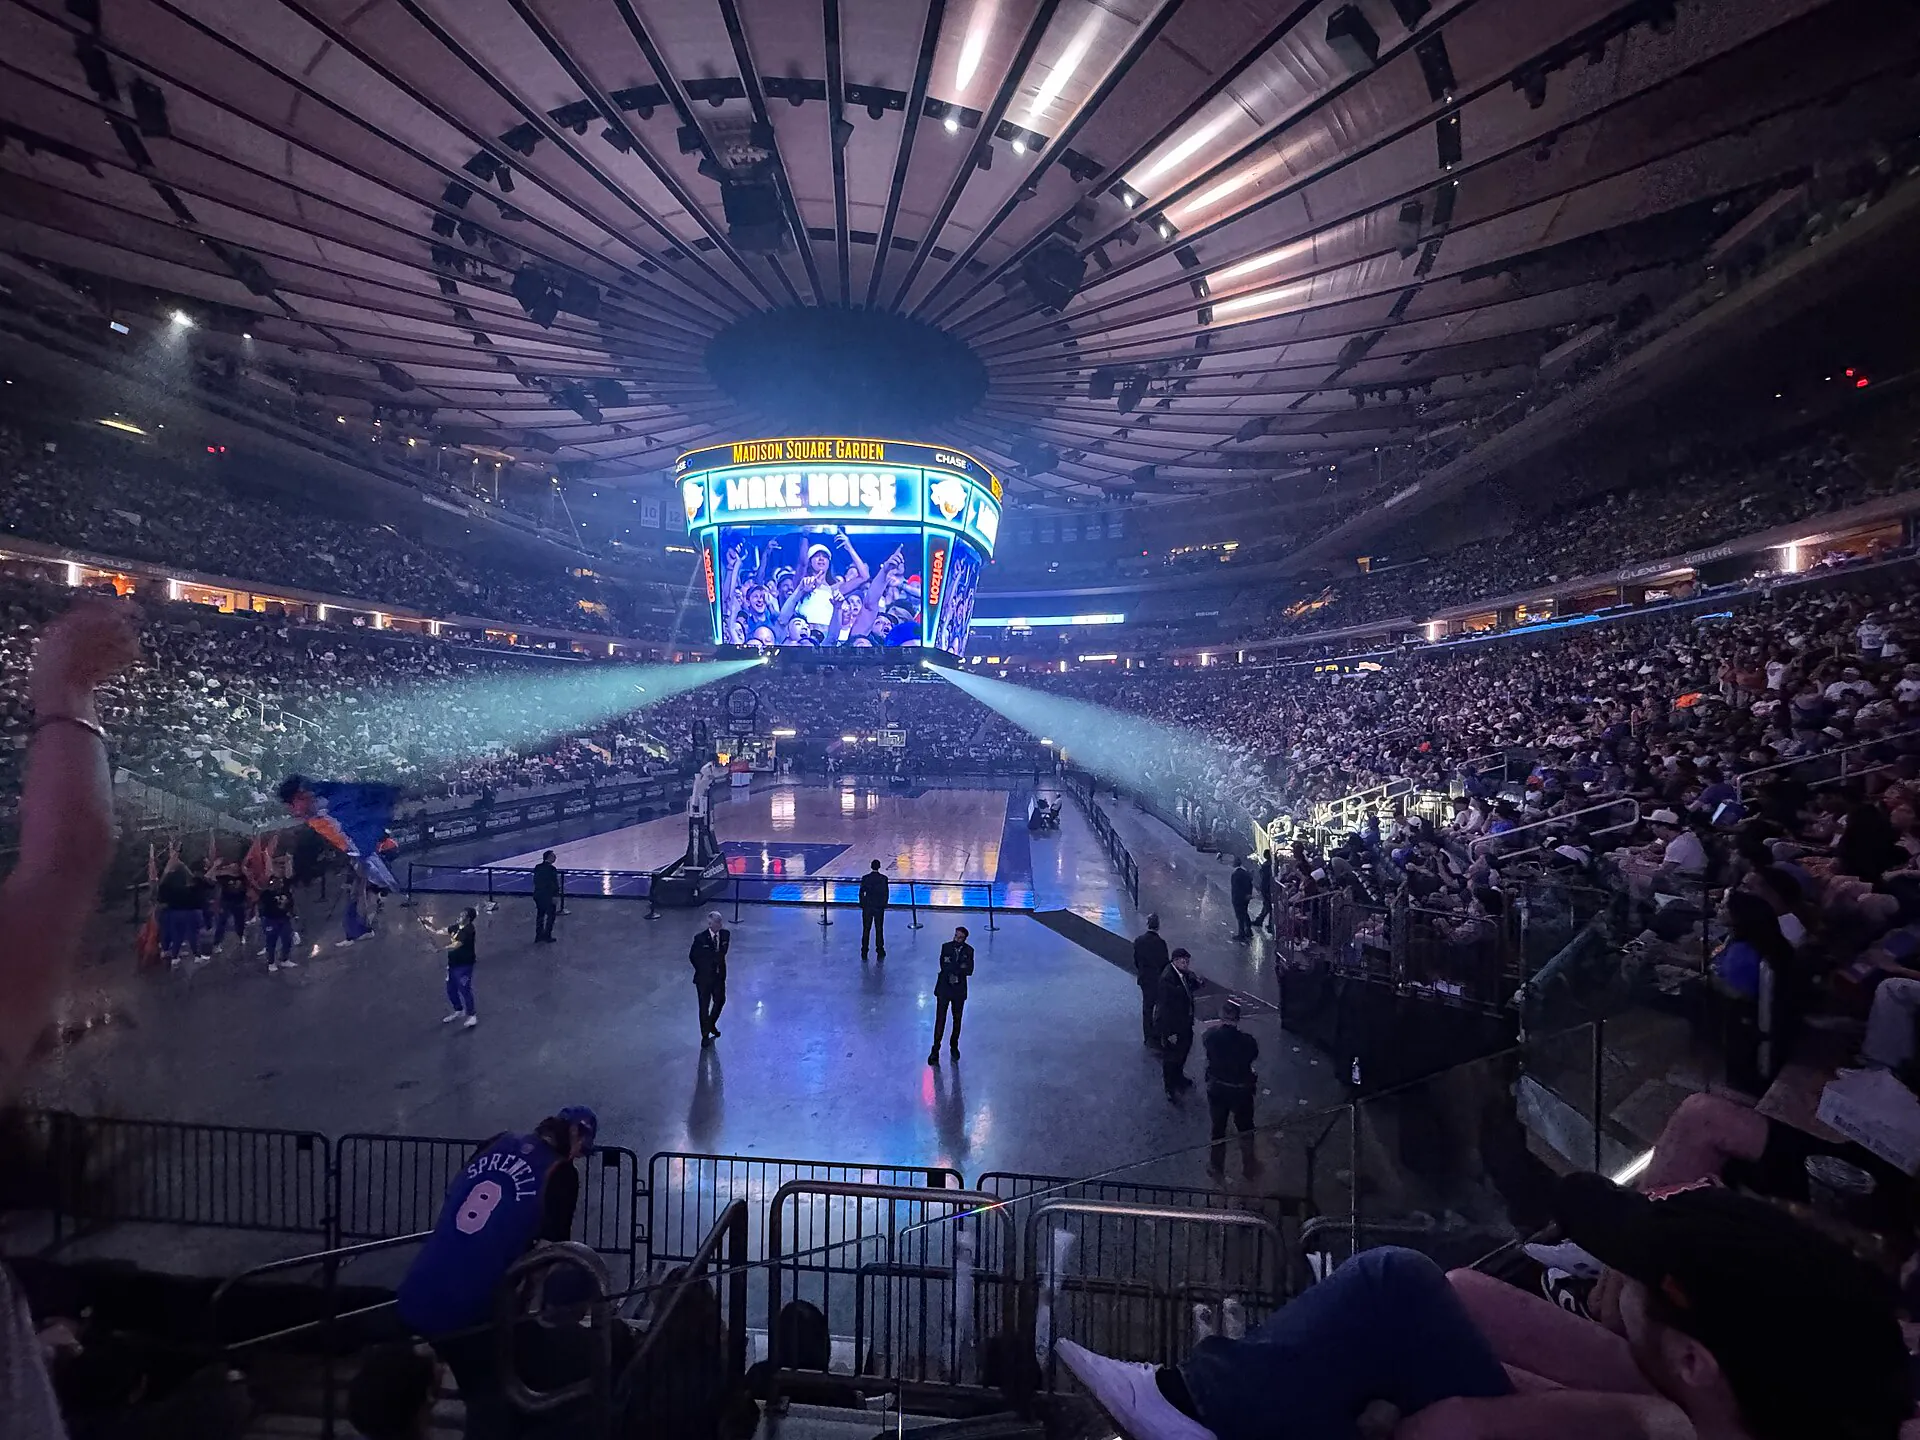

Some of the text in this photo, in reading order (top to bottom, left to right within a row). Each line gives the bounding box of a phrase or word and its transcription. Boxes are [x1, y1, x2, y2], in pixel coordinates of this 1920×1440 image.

[733, 440, 884, 463] MADISON SQUARE GARDEN
[936, 453, 967, 469] CHASE
[727, 472, 897, 510] MAKE NOISE
[1708, 547, 1733, 562] LEVEL
[704, 548, 716, 603] verizon
[929, 549, 944, 605] verizon
[1631, 562, 1671, 578] LEXUS
[703, 863, 725, 879] coinbase
[467, 1153, 537, 1202] SPREWELL
[455, 1180, 502, 1235] 8
